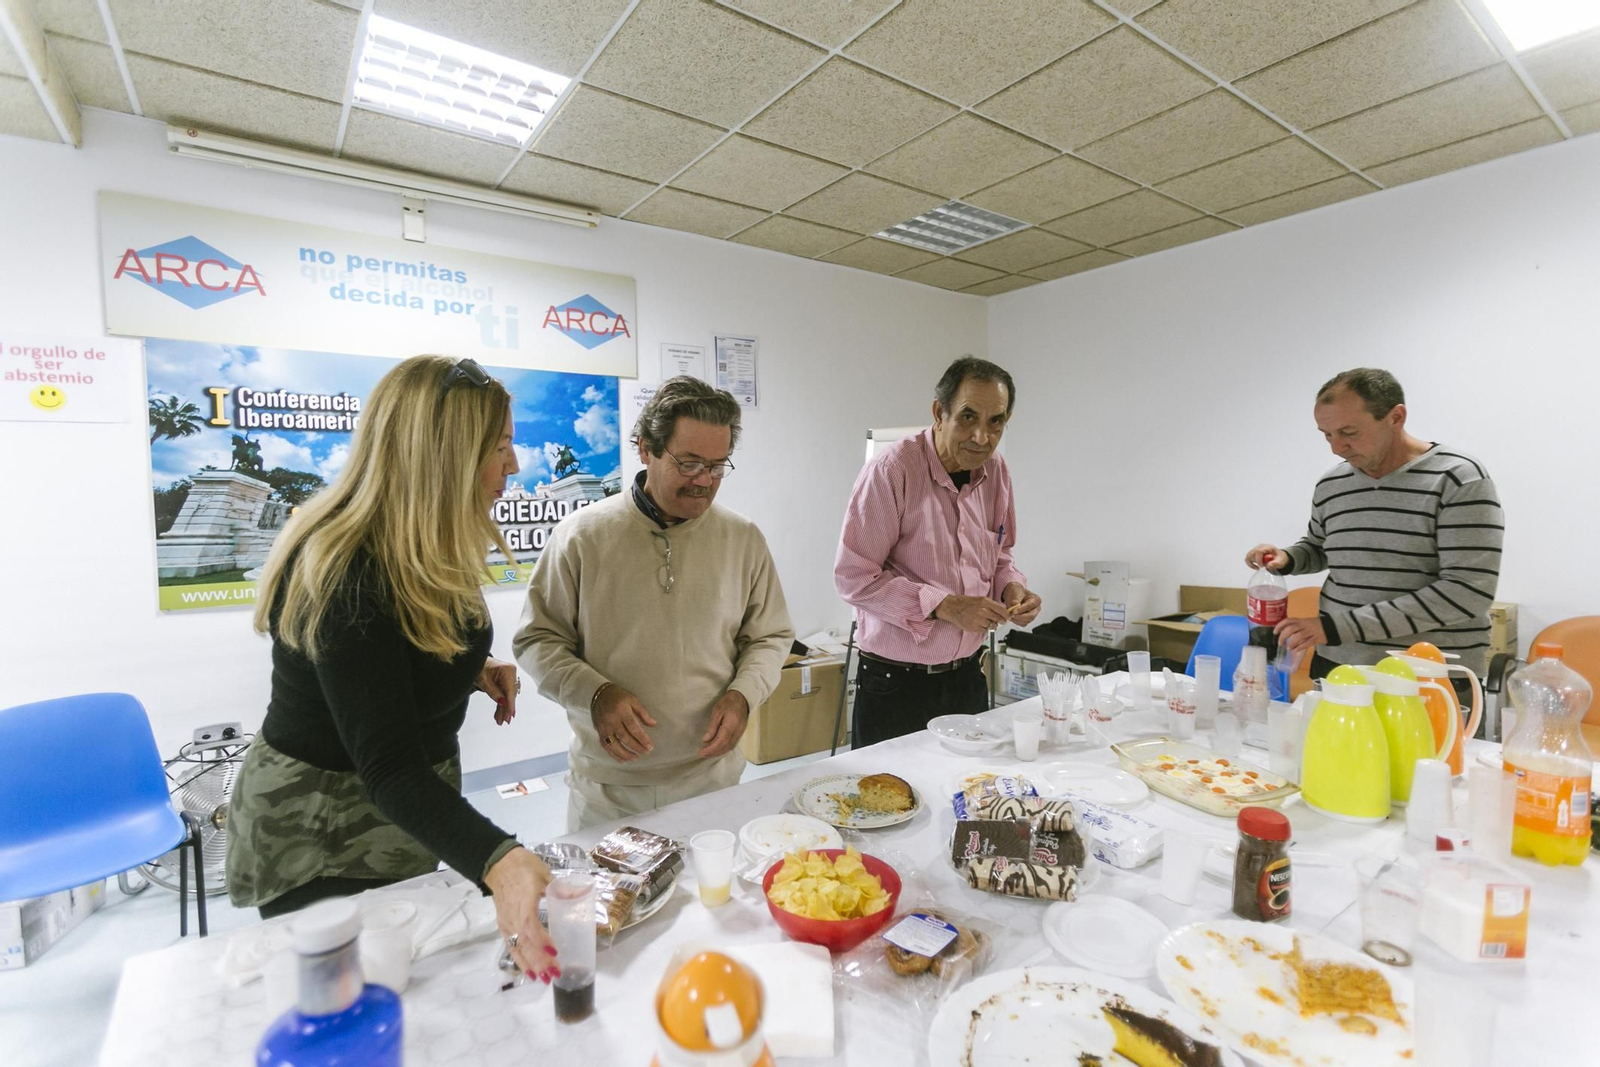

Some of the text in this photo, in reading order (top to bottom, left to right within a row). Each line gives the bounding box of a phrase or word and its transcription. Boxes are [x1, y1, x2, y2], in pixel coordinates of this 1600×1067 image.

[113, 248, 267, 296] ARCA
[299, 247, 467, 284] no permitas
[300, 264, 494, 302] que el alcohol
[329, 282, 475, 316] decida por
[475, 304, 519, 350] ti
[542, 305, 631, 338] ARCA
[9, 345, 78, 360] orgullo
[83, 347, 106, 360] de
[35, 360, 63, 370] ser
[4, 369, 94, 385] abstemio
[208, 387, 231, 426] I
[238, 387, 361, 412] Conferencia
[490, 528, 546, 551] GLO
[181, 586, 260, 603] www.un
